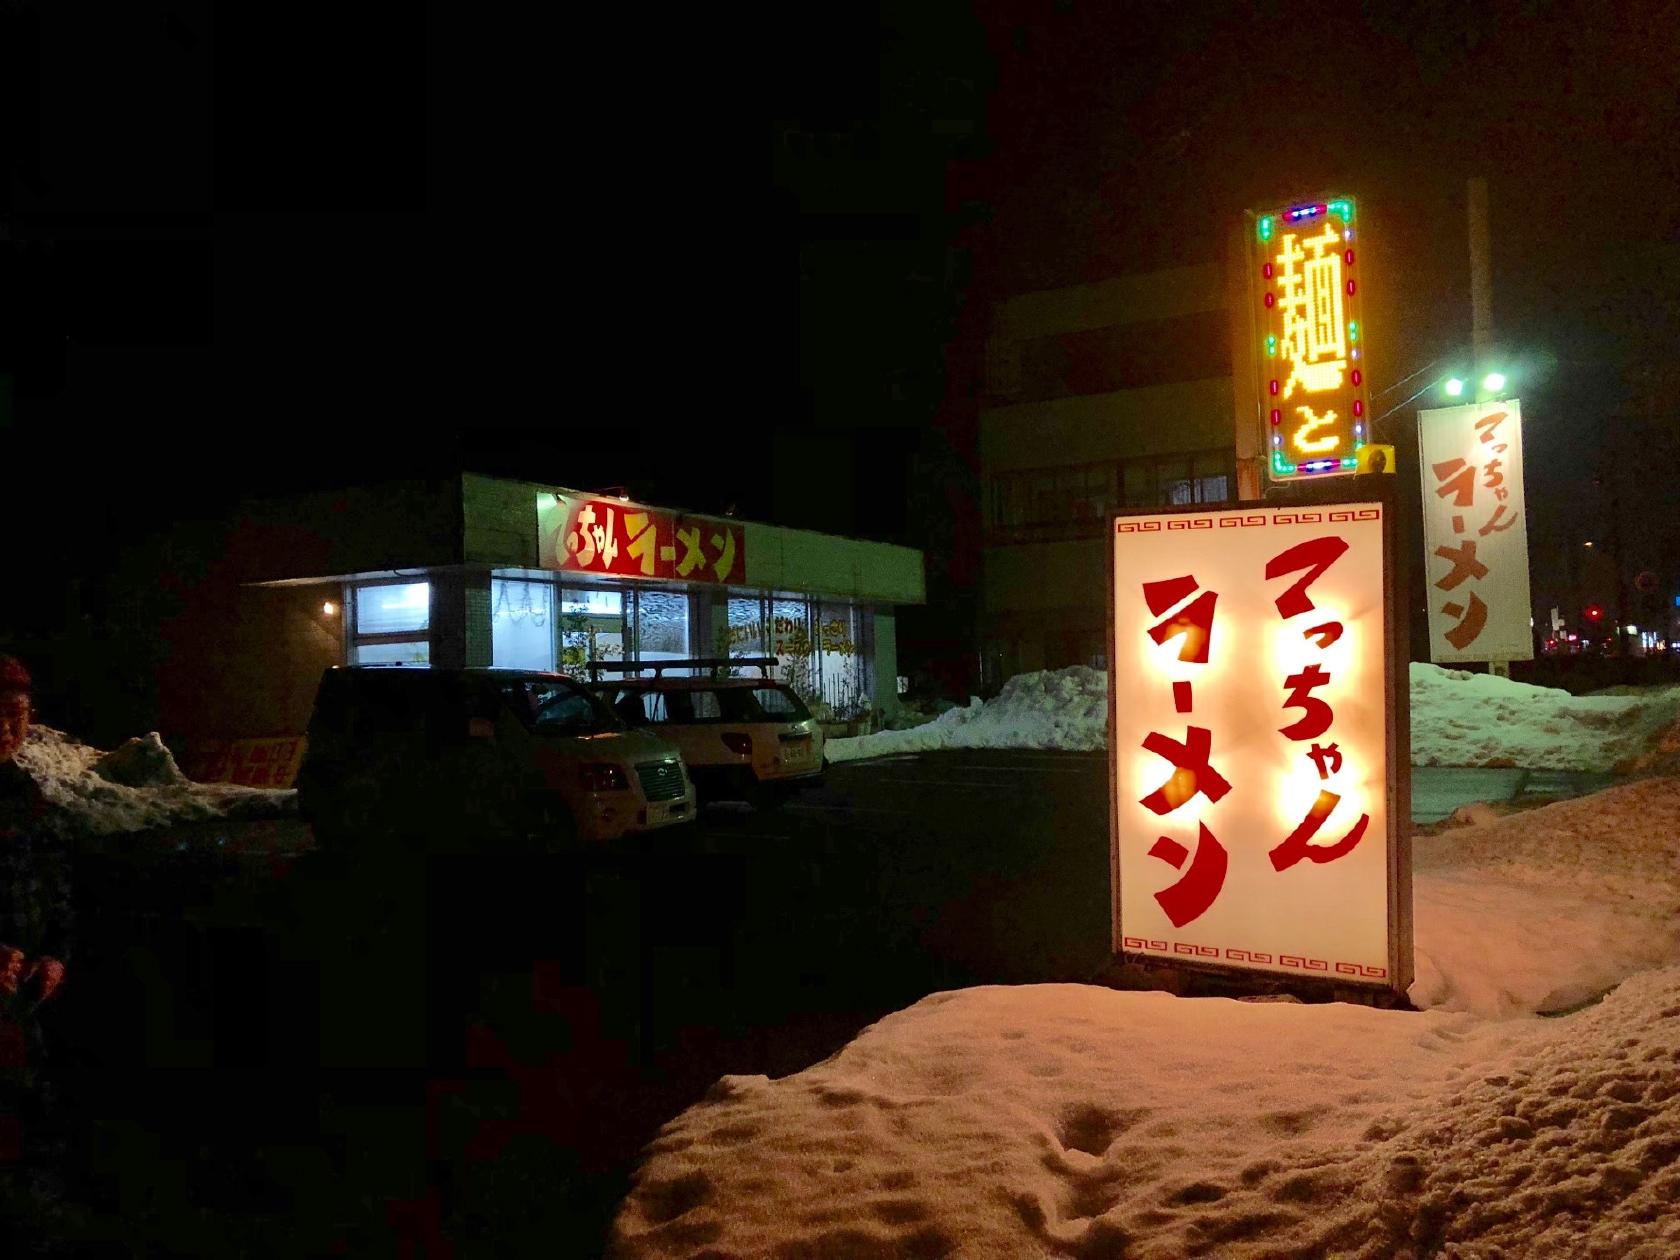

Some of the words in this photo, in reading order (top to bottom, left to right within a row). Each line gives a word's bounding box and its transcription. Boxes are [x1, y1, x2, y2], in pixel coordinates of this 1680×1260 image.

[1276, 221, 1346, 453] 麺と
[623, 512, 736, 583] ラーメン
[1431, 457, 1490, 651] ラーメン
[1474, 411, 1519, 537] マっちゃん
[1139, 573, 1233, 929] ラーメン
[1264, 535, 1370, 873] マっちゃん
